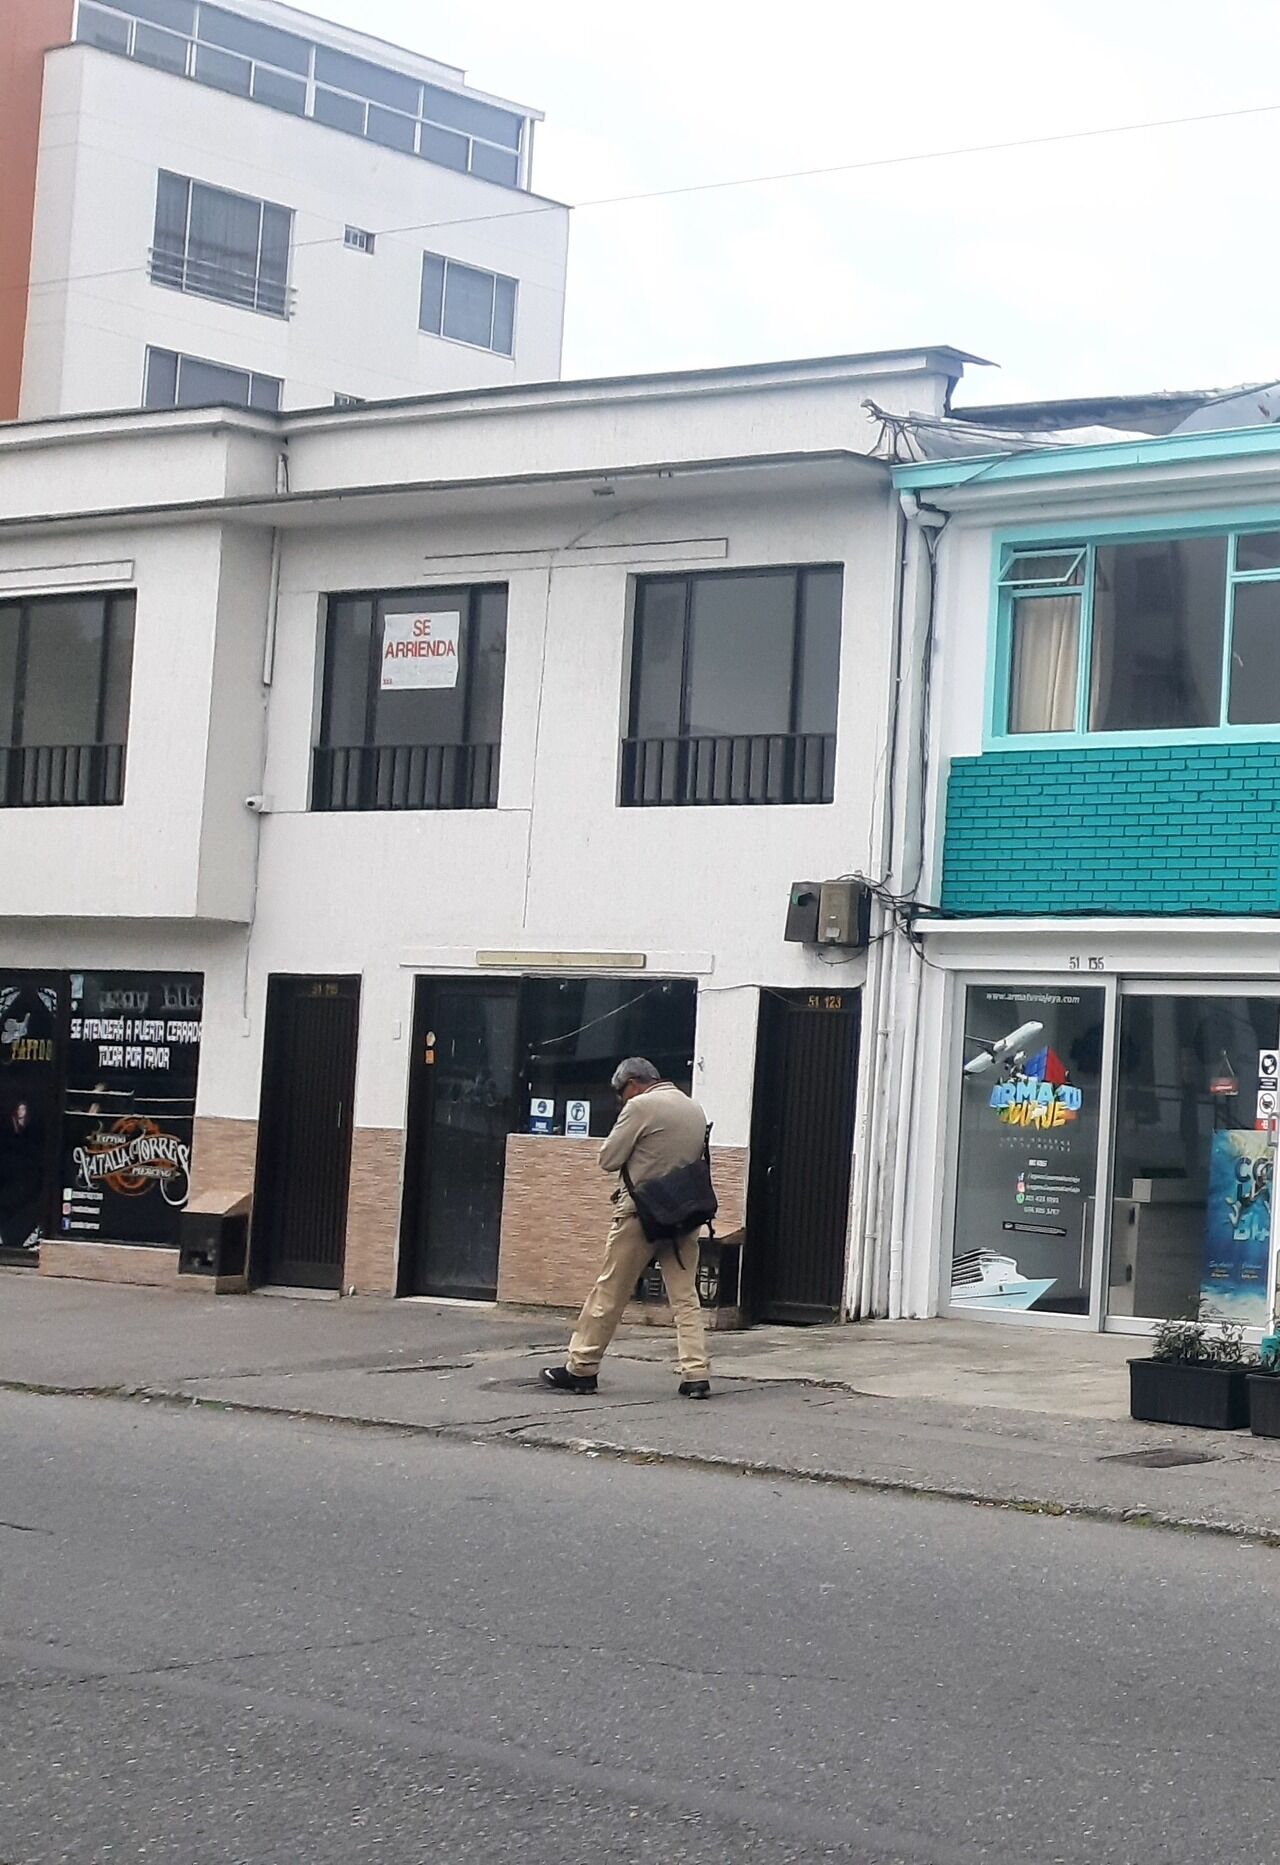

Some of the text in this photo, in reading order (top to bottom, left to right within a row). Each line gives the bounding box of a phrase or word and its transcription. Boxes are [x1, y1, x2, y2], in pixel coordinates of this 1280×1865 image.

[413, 619, 431, 636] SE
[385, 640, 456, 659] ARRIENDA
[1069, 956, 1105, 970] 51 135
[70, 1018, 83, 1040] SE
[125, 1019, 132, 1042] A
[133, 1019, 165, 1044] PUERTA
[98, 1045, 171, 1071] TOCAR POR FAVOR
[990, 1081, 1083, 1111] ARMA TU
[73, 1143, 132, 1189] NATALIA
